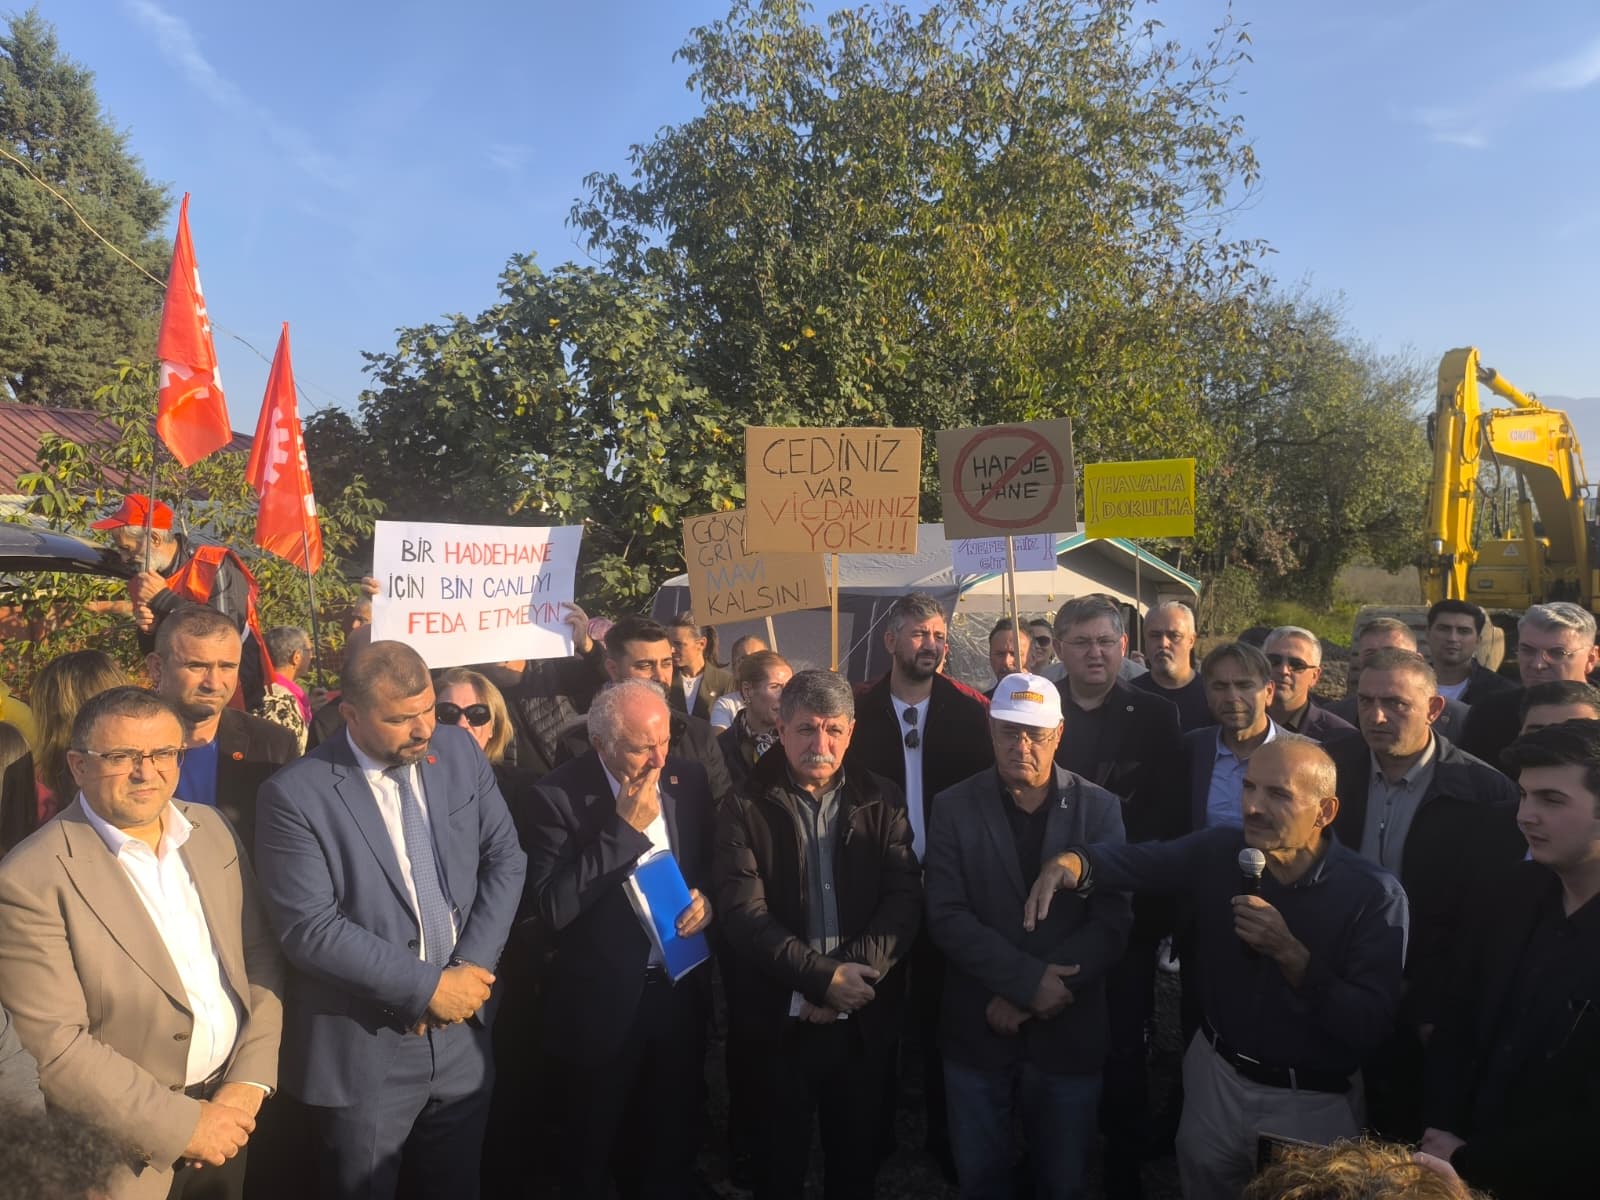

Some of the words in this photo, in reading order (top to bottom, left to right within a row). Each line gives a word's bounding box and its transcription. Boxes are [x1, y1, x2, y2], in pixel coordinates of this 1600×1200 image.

[762, 433, 901, 479] ÇEDİNİZ
[803, 476, 853, 499] VAR
[981, 481, 1041, 500] HANE
[760, 491, 918, 526] VİCDANINIZ
[692, 515, 746, 544] GÖKY
[801, 521, 907, 551] YOK!!!
[401, 537, 435, 564] BİR
[445, 541, 554, 566] HADDEHANE
[389, 573, 425, 600] İÇİN
[441, 575, 473, 599] BİN
[483, 572, 551, 598] CANLIYI
[707, 579, 808, 617] KALSIN!
[408, 611, 467, 634] FEDA
[479, 601, 561, 631] ETMEYİN
